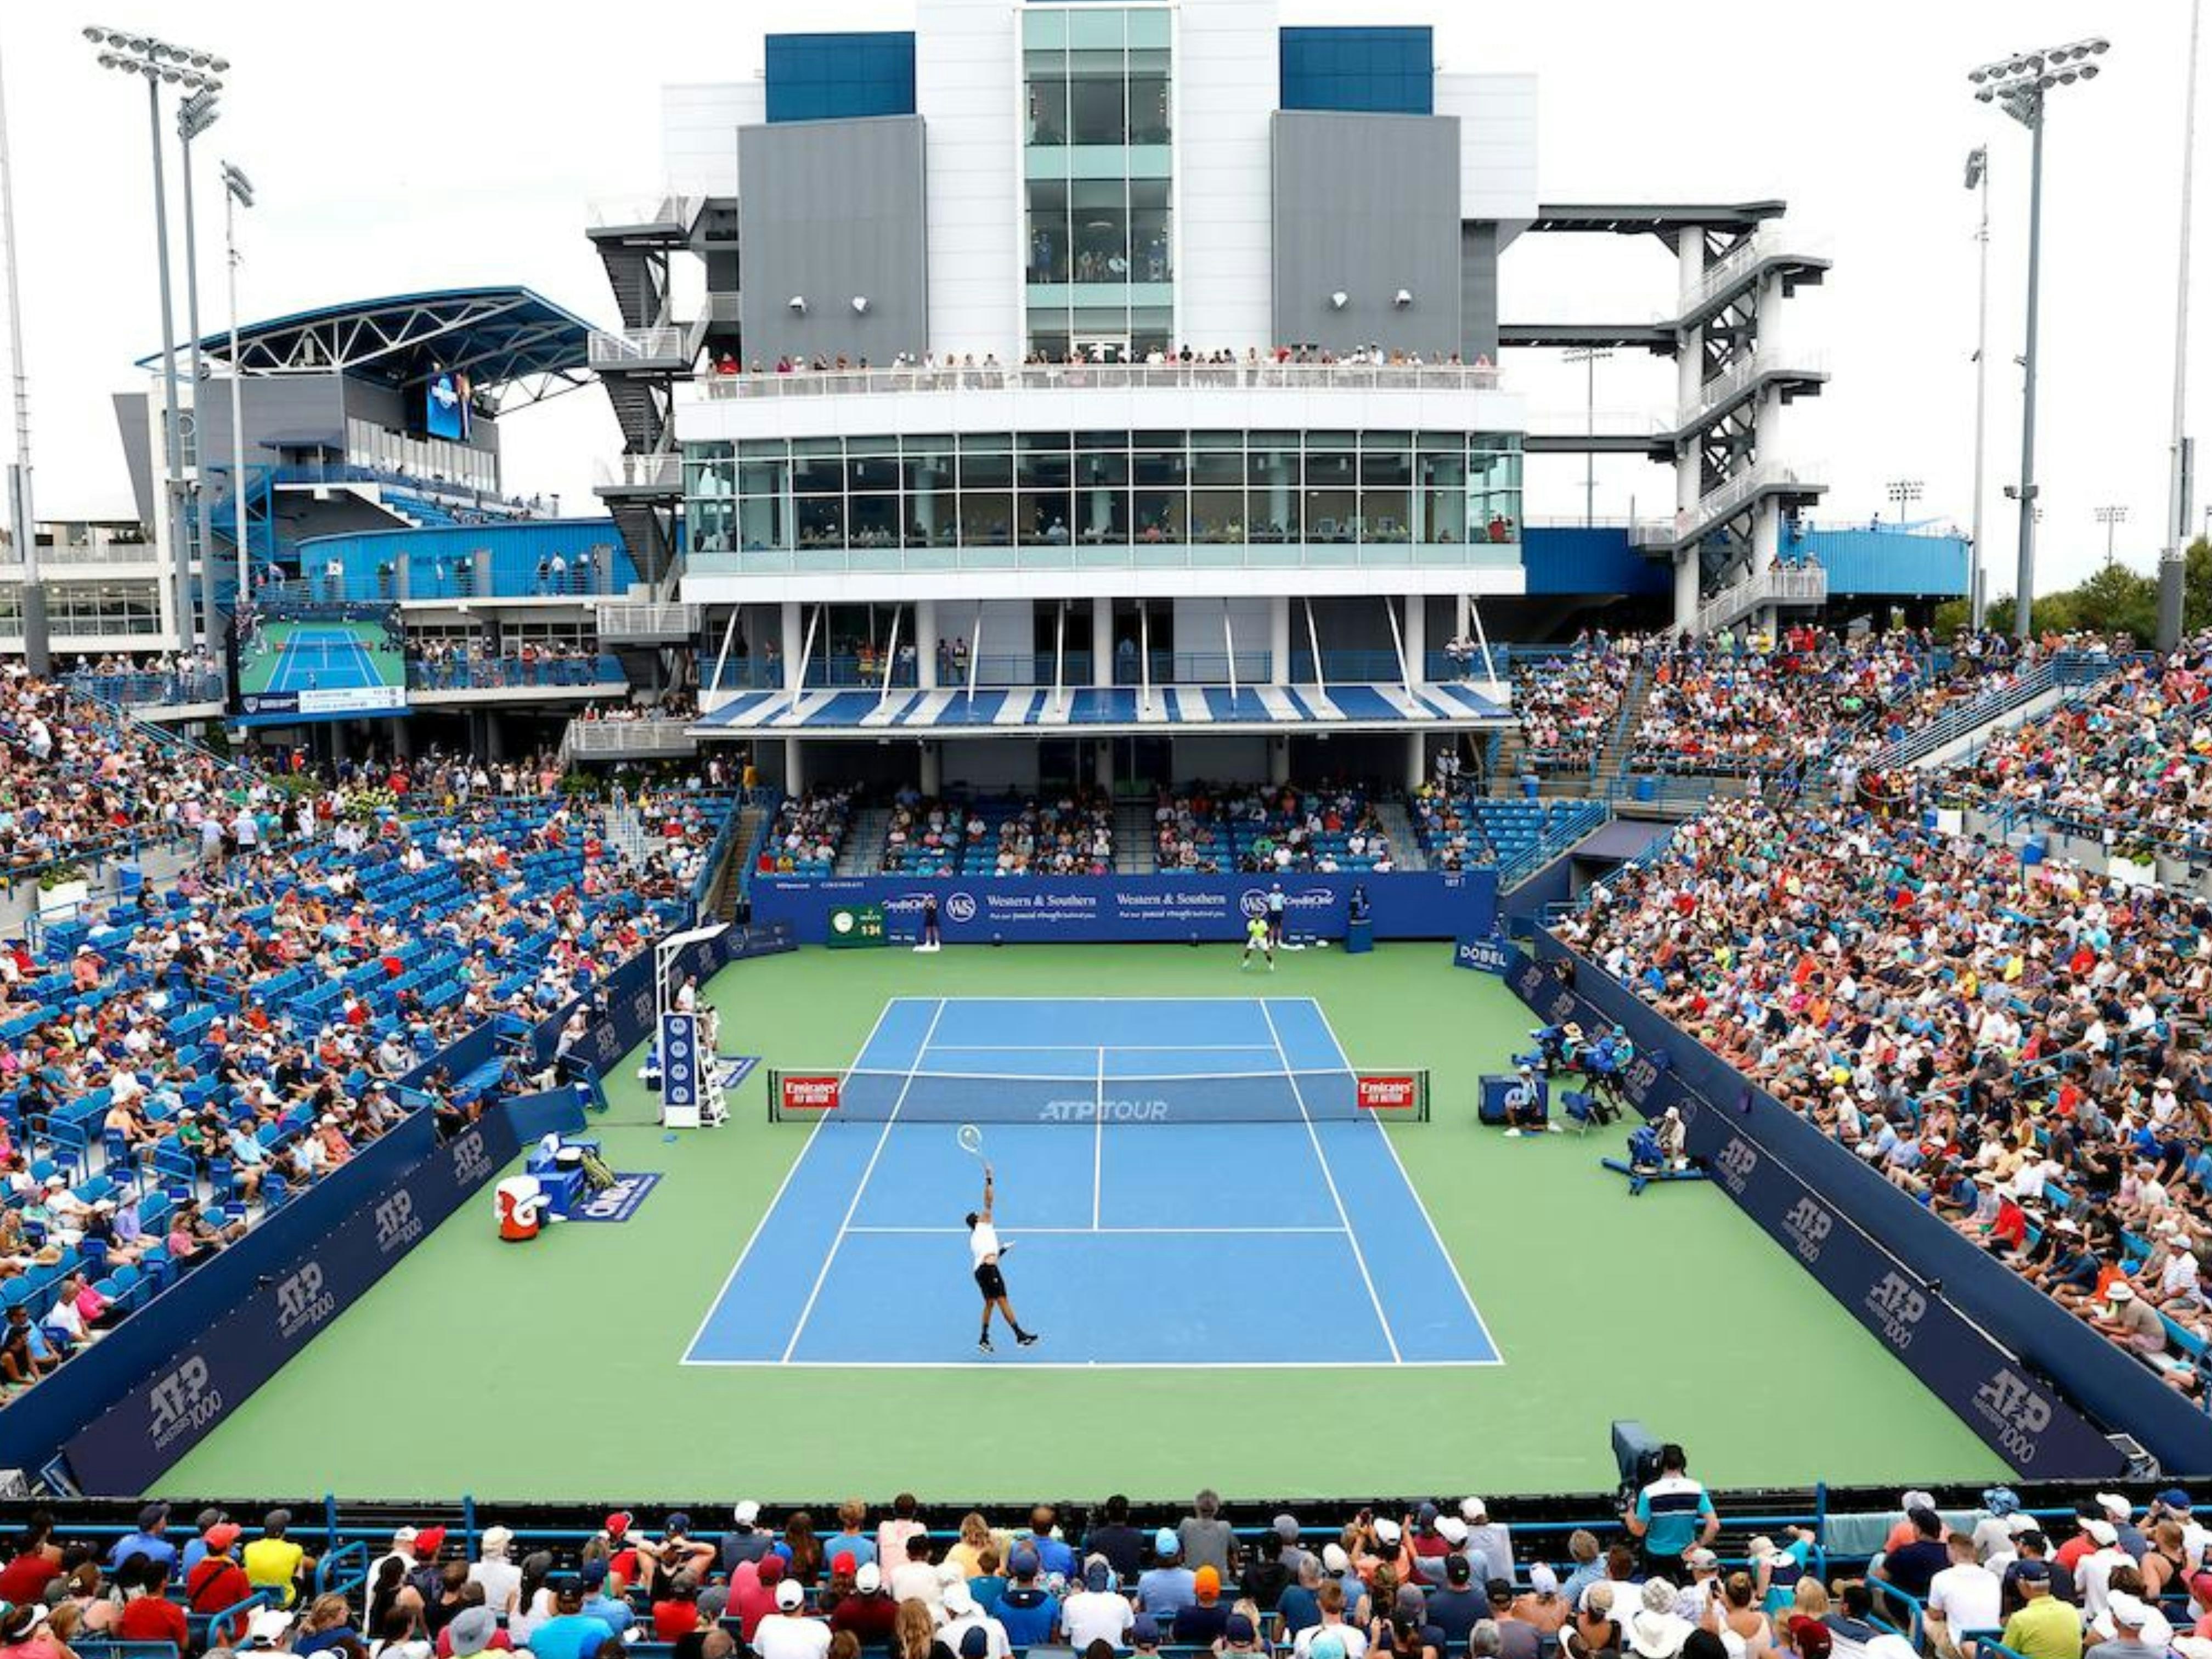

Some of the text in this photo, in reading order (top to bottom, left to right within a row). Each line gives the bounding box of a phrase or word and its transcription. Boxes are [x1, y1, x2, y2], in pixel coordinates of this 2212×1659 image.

[988, 894, 1096, 906] Western & Southern
[1117, 893, 1227, 905] Western & Southern
[1460, 946, 1507, 967] DOBEL
[786, 1082, 838, 1094] Emirates
[1361, 1082, 1414, 1094] Emirates
[1040, 1100, 1167, 1120] ATP TOUR
[1718, 1137, 1757, 1175] ATP
[375, 1188, 412, 1243] ATP
[1785, 1197, 1833, 1240] ATP
[277, 1262, 324, 1328] ATP
[309, 1291, 335, 1325] 1000
[1870, 1270, 1927, 1324] ATP
[1883, 1318, 1912, 1350] 1000
[148, 1355, 208, 1438] ATP
[190, 1389, 222, 1430] 1000
[1978, 1368, 2052, 1434] ATP
[1997, 1422, 2036, 1464] 1000
